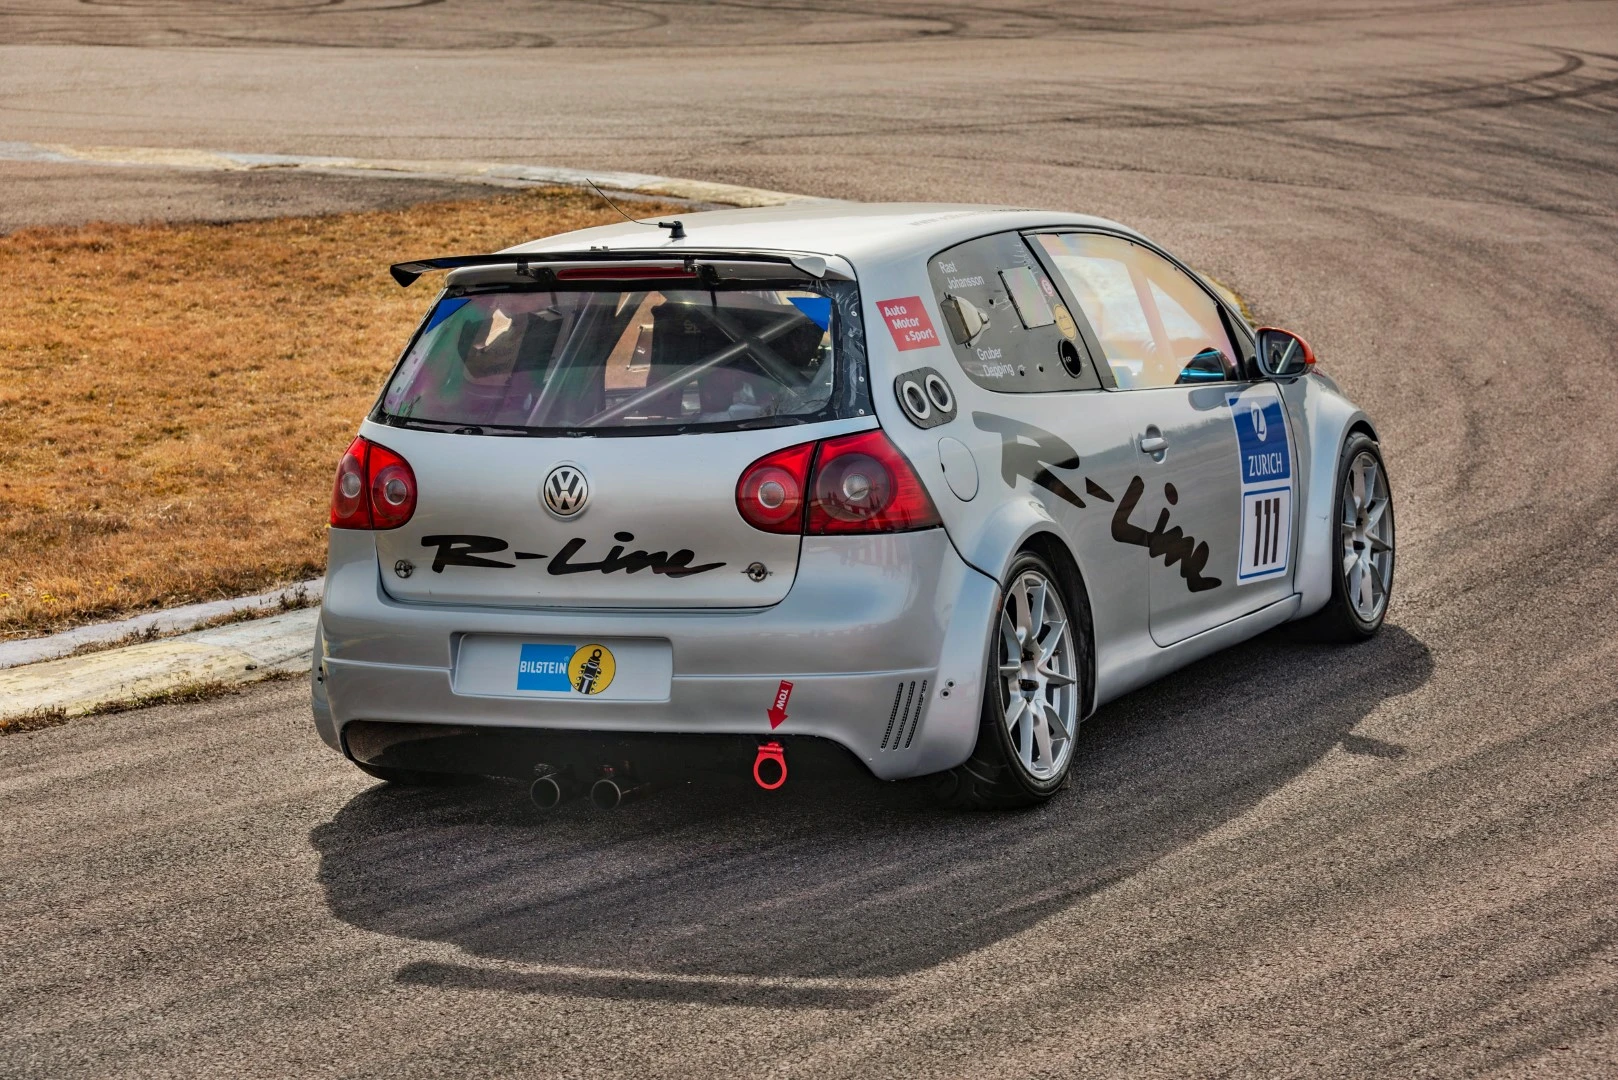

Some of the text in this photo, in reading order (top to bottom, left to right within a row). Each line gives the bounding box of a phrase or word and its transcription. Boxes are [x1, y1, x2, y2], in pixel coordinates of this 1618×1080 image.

[938, 260, 958, 274] Rast
[946, 275, 985, 290] Johansson
[883, 304, 907, 317] Auto
[891, 317, 920, 330] Motor
[1248, 451, 1283, 477] ZURICH
[971, 410, 1223, 593] R-Line
[1253, 497, 1281, 567] 111
[420, 531, 727, 578] R-Line
[520, 660, 567, 675] BILSTEIN
[776, 689, 789, 710] TOW
